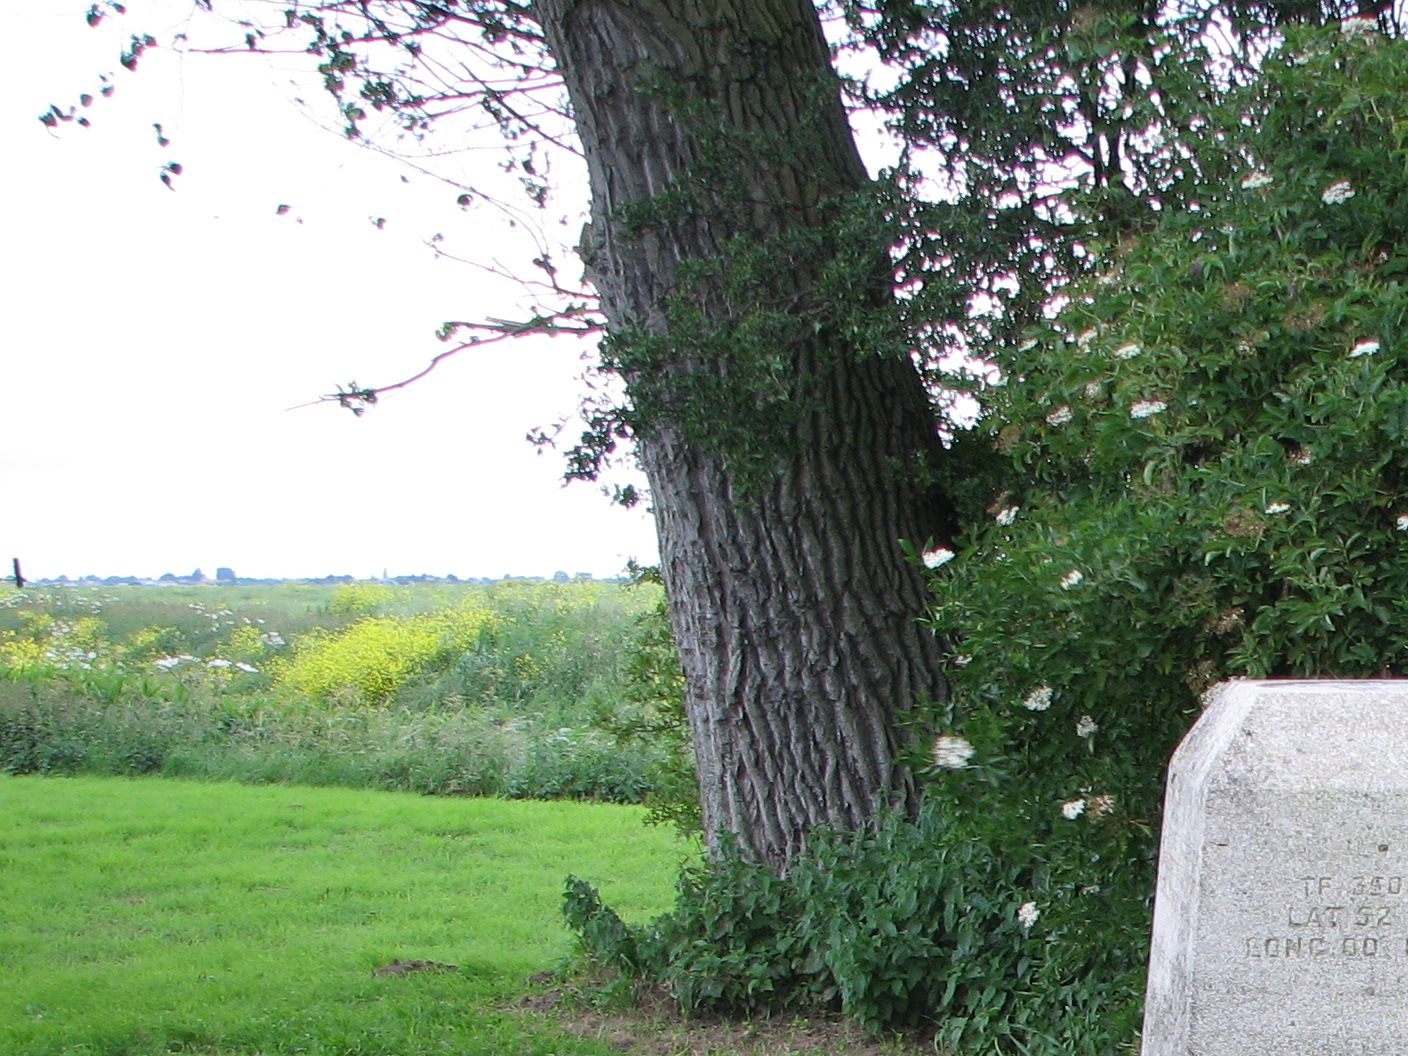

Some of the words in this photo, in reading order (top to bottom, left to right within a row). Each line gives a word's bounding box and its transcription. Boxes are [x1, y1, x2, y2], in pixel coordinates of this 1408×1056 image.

[1299, 876, 1332, 897] TF
[1288, 906, 1345, 927] LAT
[1355, 906, 1392, 928] 52
[1342, 937, 1378, 957] 00
